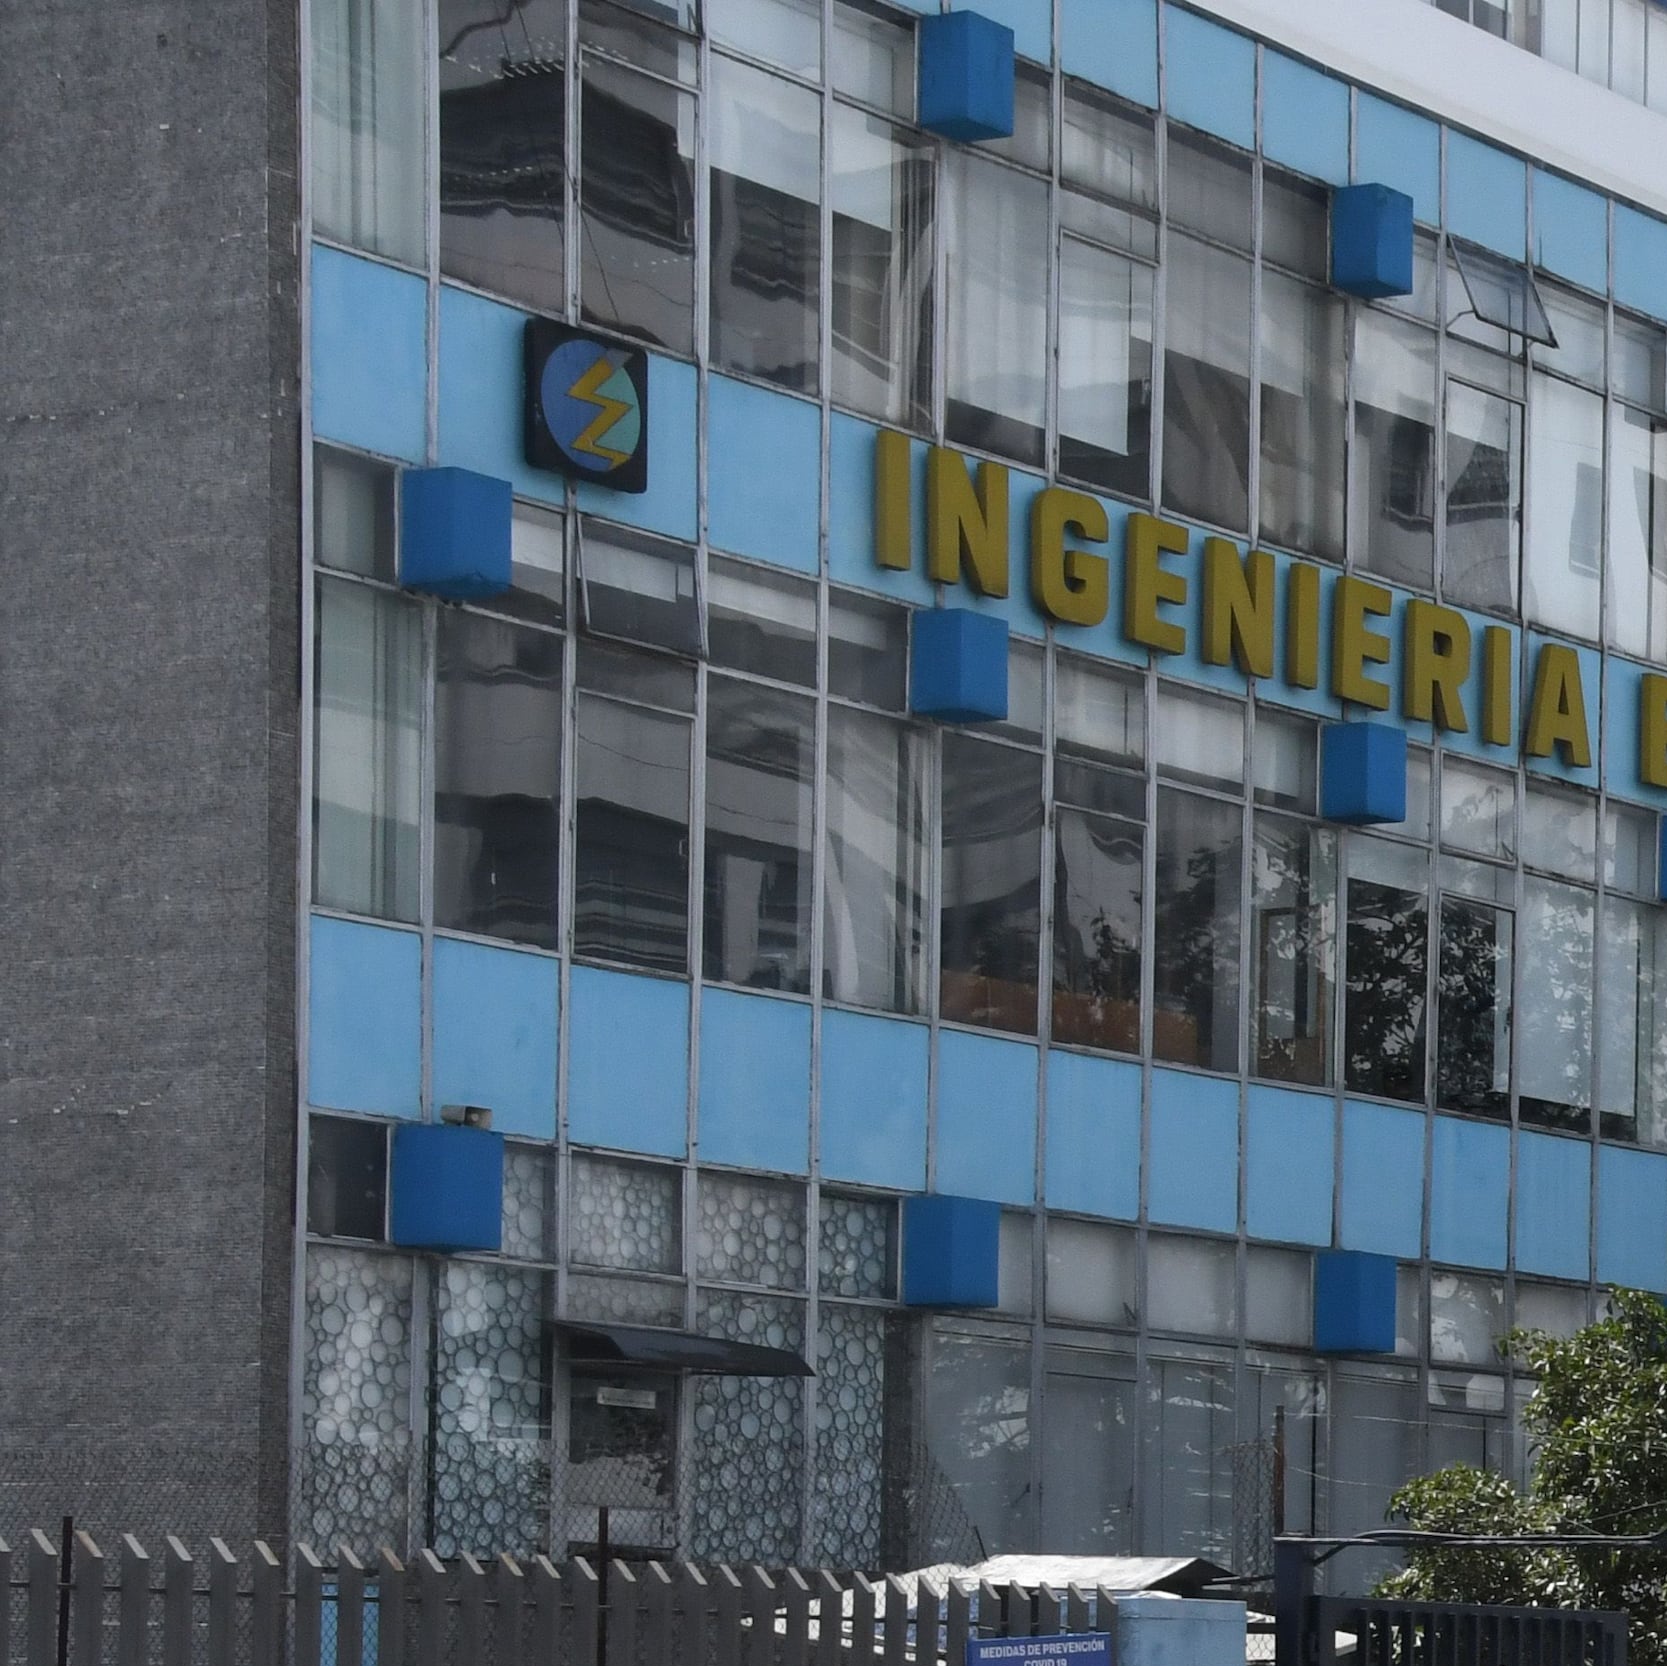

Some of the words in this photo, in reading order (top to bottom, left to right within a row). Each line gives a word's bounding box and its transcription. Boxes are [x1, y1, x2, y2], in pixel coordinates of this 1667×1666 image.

[876, 429, 1592, 768] INGENIERIA
[980, 1645, 1026, 1659] MEDIDAS
[1027, 1643, 1041, 1656] DE
[1043, 1638, 1105, 1656] PREVENCIÓN
